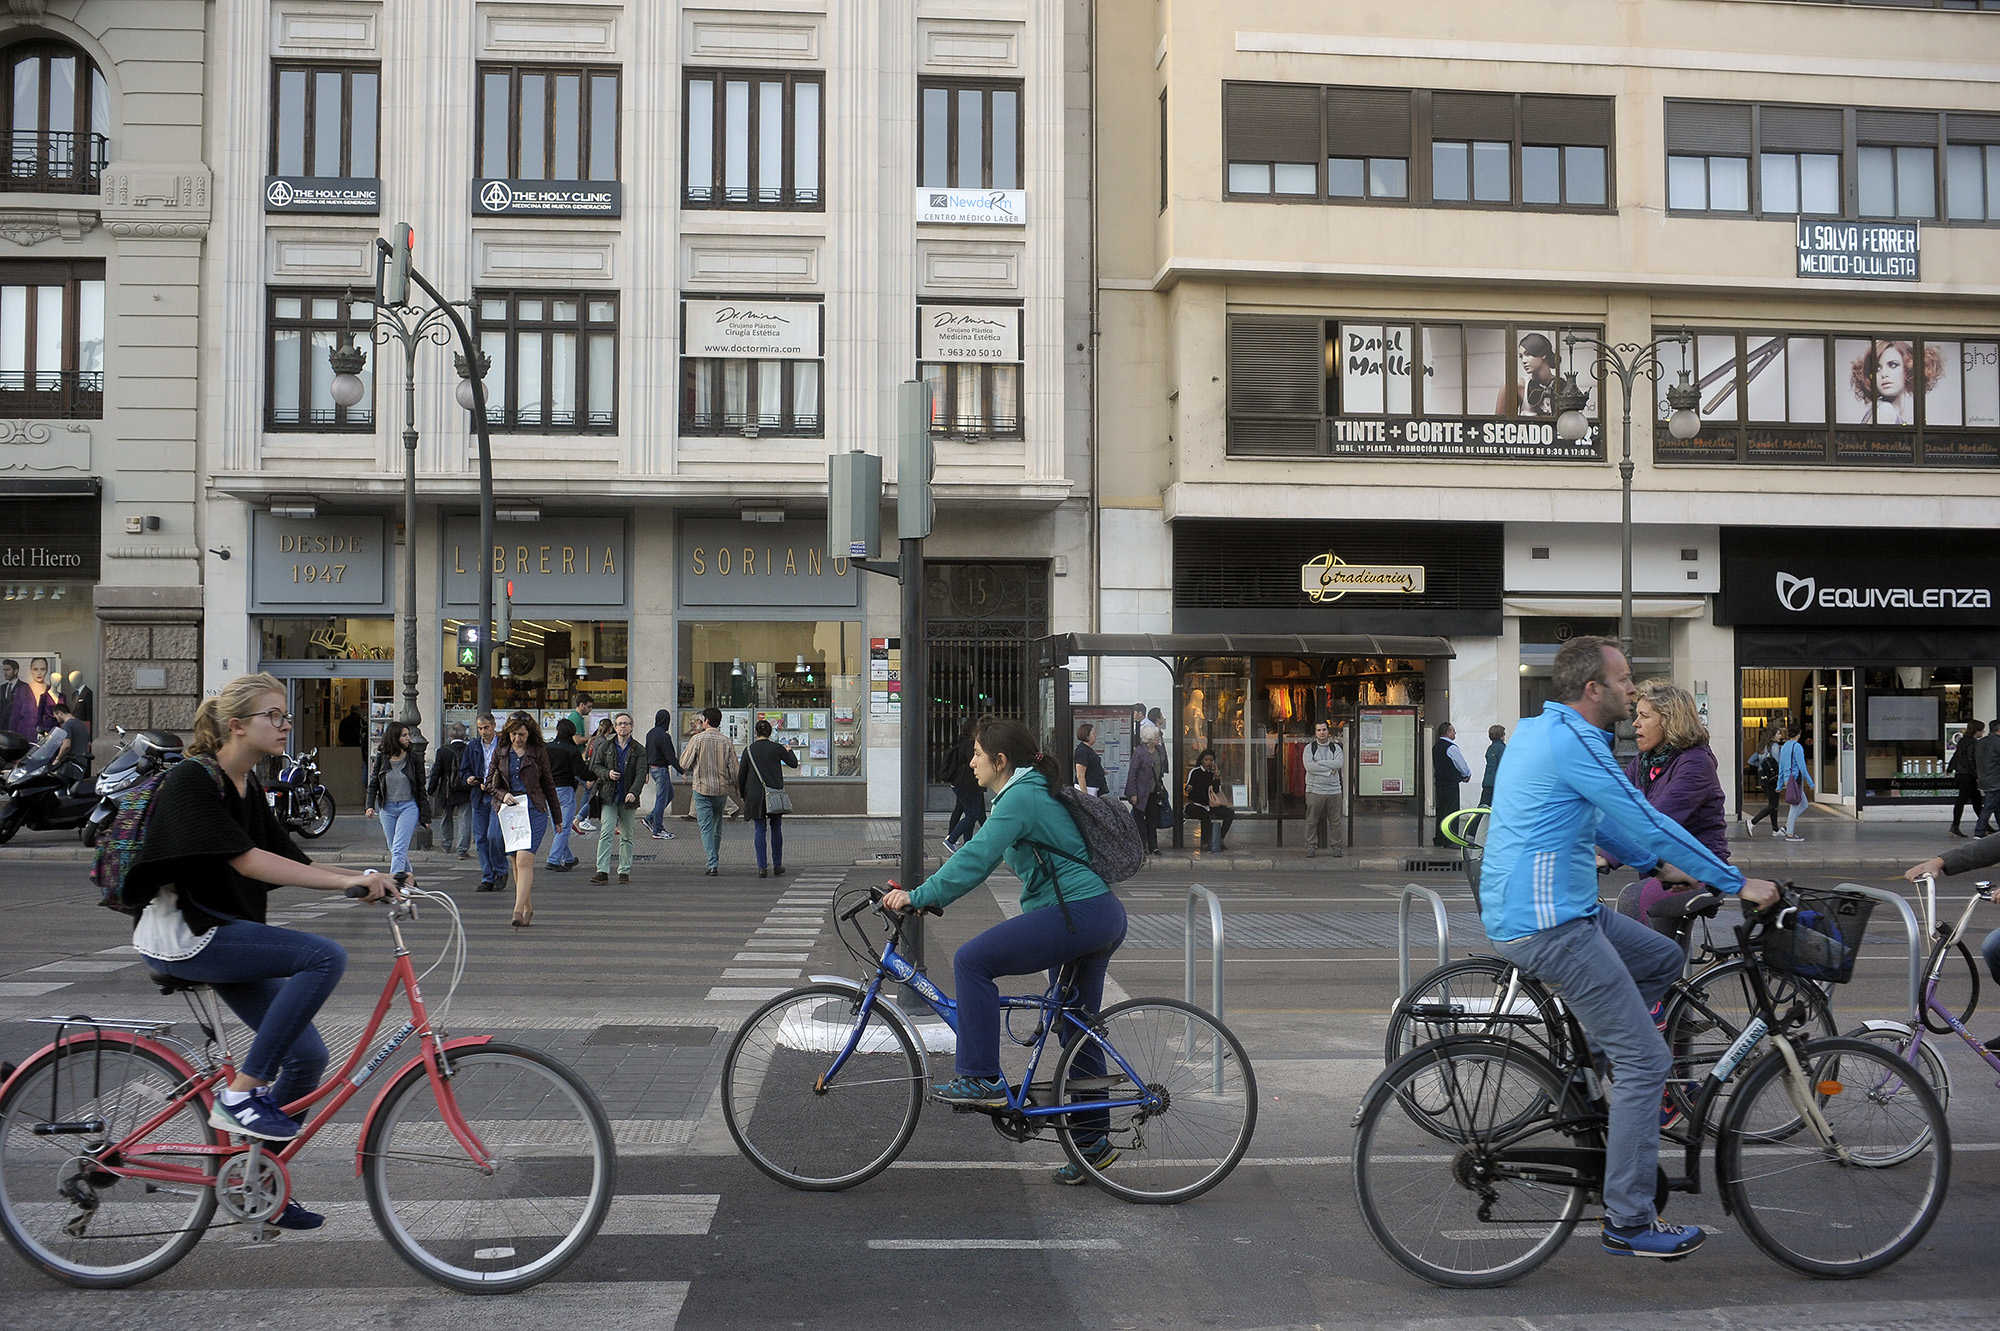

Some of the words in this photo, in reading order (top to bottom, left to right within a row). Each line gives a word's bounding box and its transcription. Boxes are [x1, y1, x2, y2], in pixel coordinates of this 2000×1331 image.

[294, 189, 314, 198] THE
[316, 190, 342, 198] HOLY
[343, 190, 376, 199] CLINIC
[512, 191, 536, 201] THE
[538, 192, 571, 201] HOLY
[572, 193, 612, 202] CLINIC
[924, 213, 956, 221] CENTRO
[1800, 226, 1812, 250] J.
[1815, 226, 1857, 251] SALVA
[1862, 228, 1915, 253] FERRER
[715, 306, 741, 323] Dr.
[934, 312, 958, 328] Dr.
[725, 329, 751, 337] Cirugía
[752, 329, 780, 337] Estética
[728, 322, 753, 330] Cirujano
[939, 333, 972, 341] Medicina
[973, 333, 1001, 341] Estética
[1349, 331, 1403, 352] Dael
[704, 344, 801, 354] www.doctormira.com
[938, 348, 946, 357] T.
[947, 348, 963, 357] 963
[966, 348, 977, 357] 20
[979, 349, 990, 357] 50
[992, 349, 1002, 358] 10
[1335, 421, 1386, 442] TINTE
[1389, 425, 1402, 438] +
[1405, 421, 1464, 443] CORTE
[1467, 426, 1479, 439] +
[1483, 422, 1553, 445] SECADO
[1396, 443, 1437, 453] PROMOCIÓN
[1440, 444, 1464, 453] VÁLIDA
[1476, 446, 1498, 454] LUNES
[1499, 446, 1504, 454] A
[1506, 447, 1535, 455] VIERNES
[1564, 448, 1569, 456] A
[1571, 448, 1589, 456] 17:00
[279, 535, 362, 553] DESDE
[2, 547, 26, 567] del
[31, 547, 81, 567] Hierro
[692, 547, 848, 576] SORIANO
[293, 563, 348, 584] 1947
[1311, 551, 1417, 603] Stradivarius
[234, 1107, 261, 1126] N
